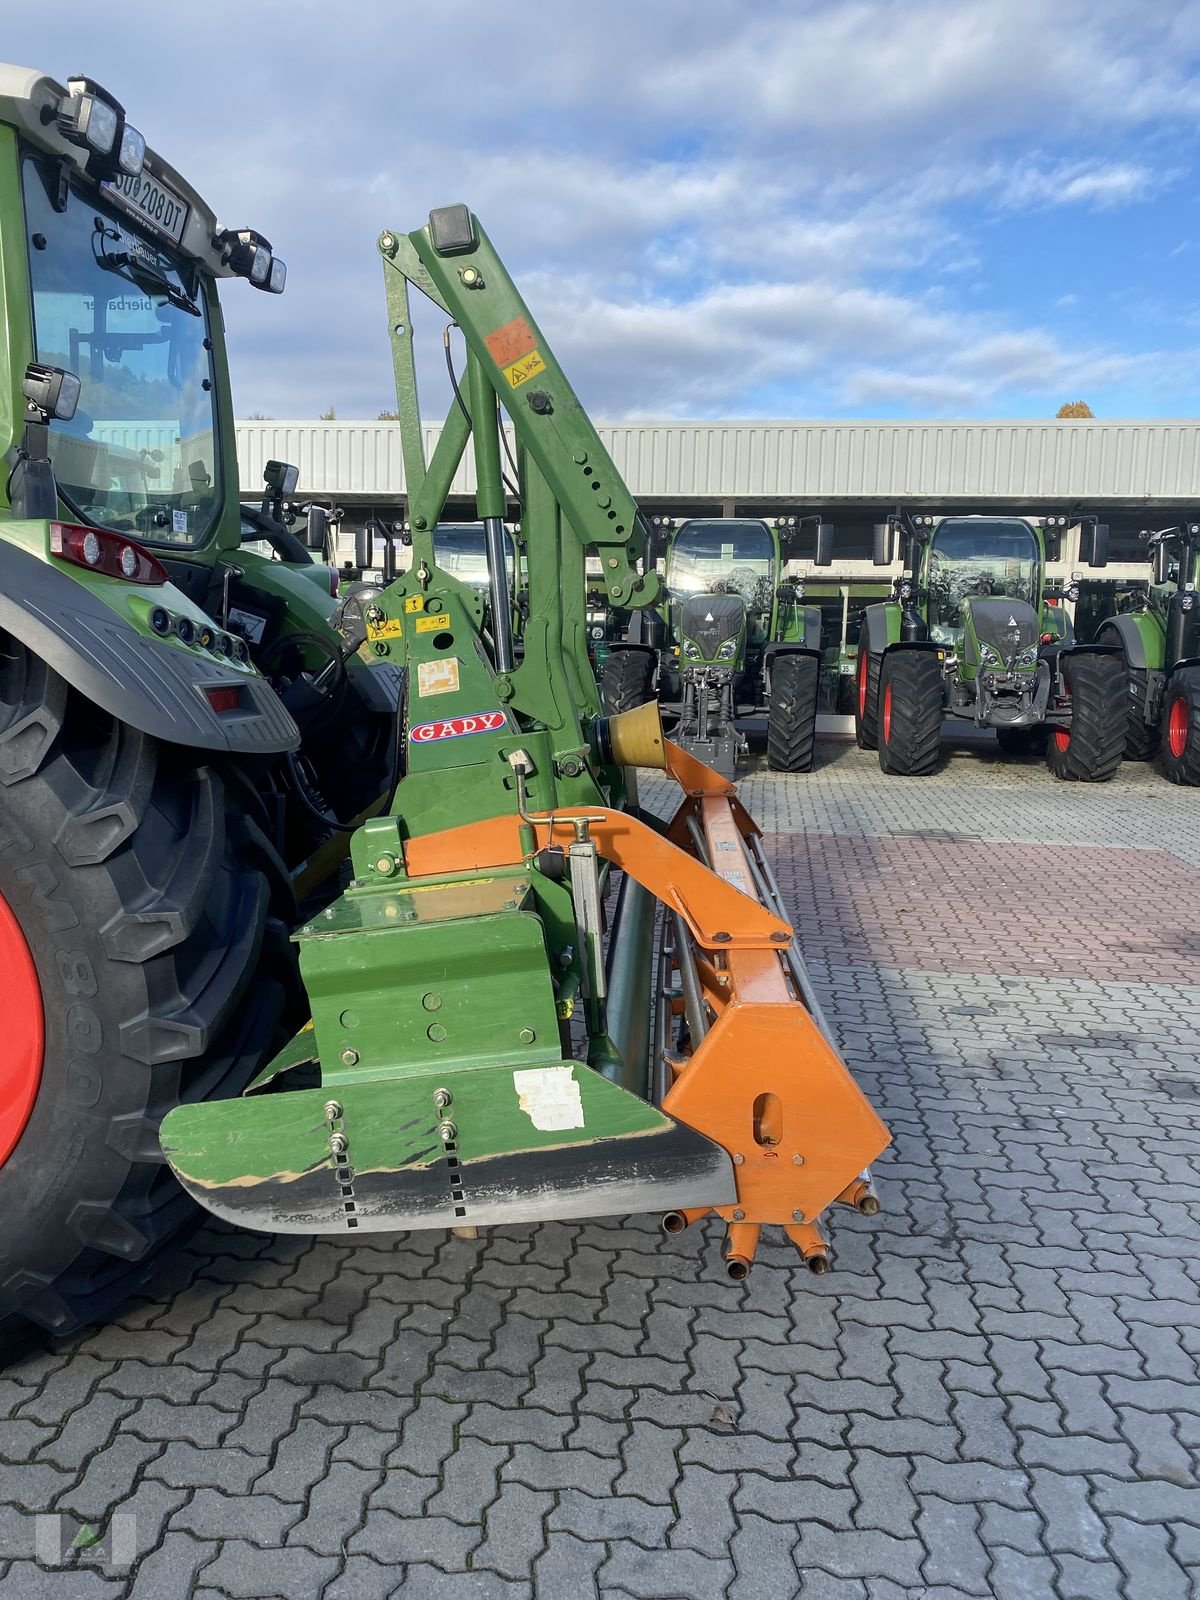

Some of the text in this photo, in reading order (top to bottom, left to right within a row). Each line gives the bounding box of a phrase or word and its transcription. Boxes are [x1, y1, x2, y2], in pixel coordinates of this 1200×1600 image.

[139, 181, 166, 221] 208
[163, 199, 182, 233] DT
[418, 713, 498, 740] GADY
[54, 948, 104, 1111] 800
